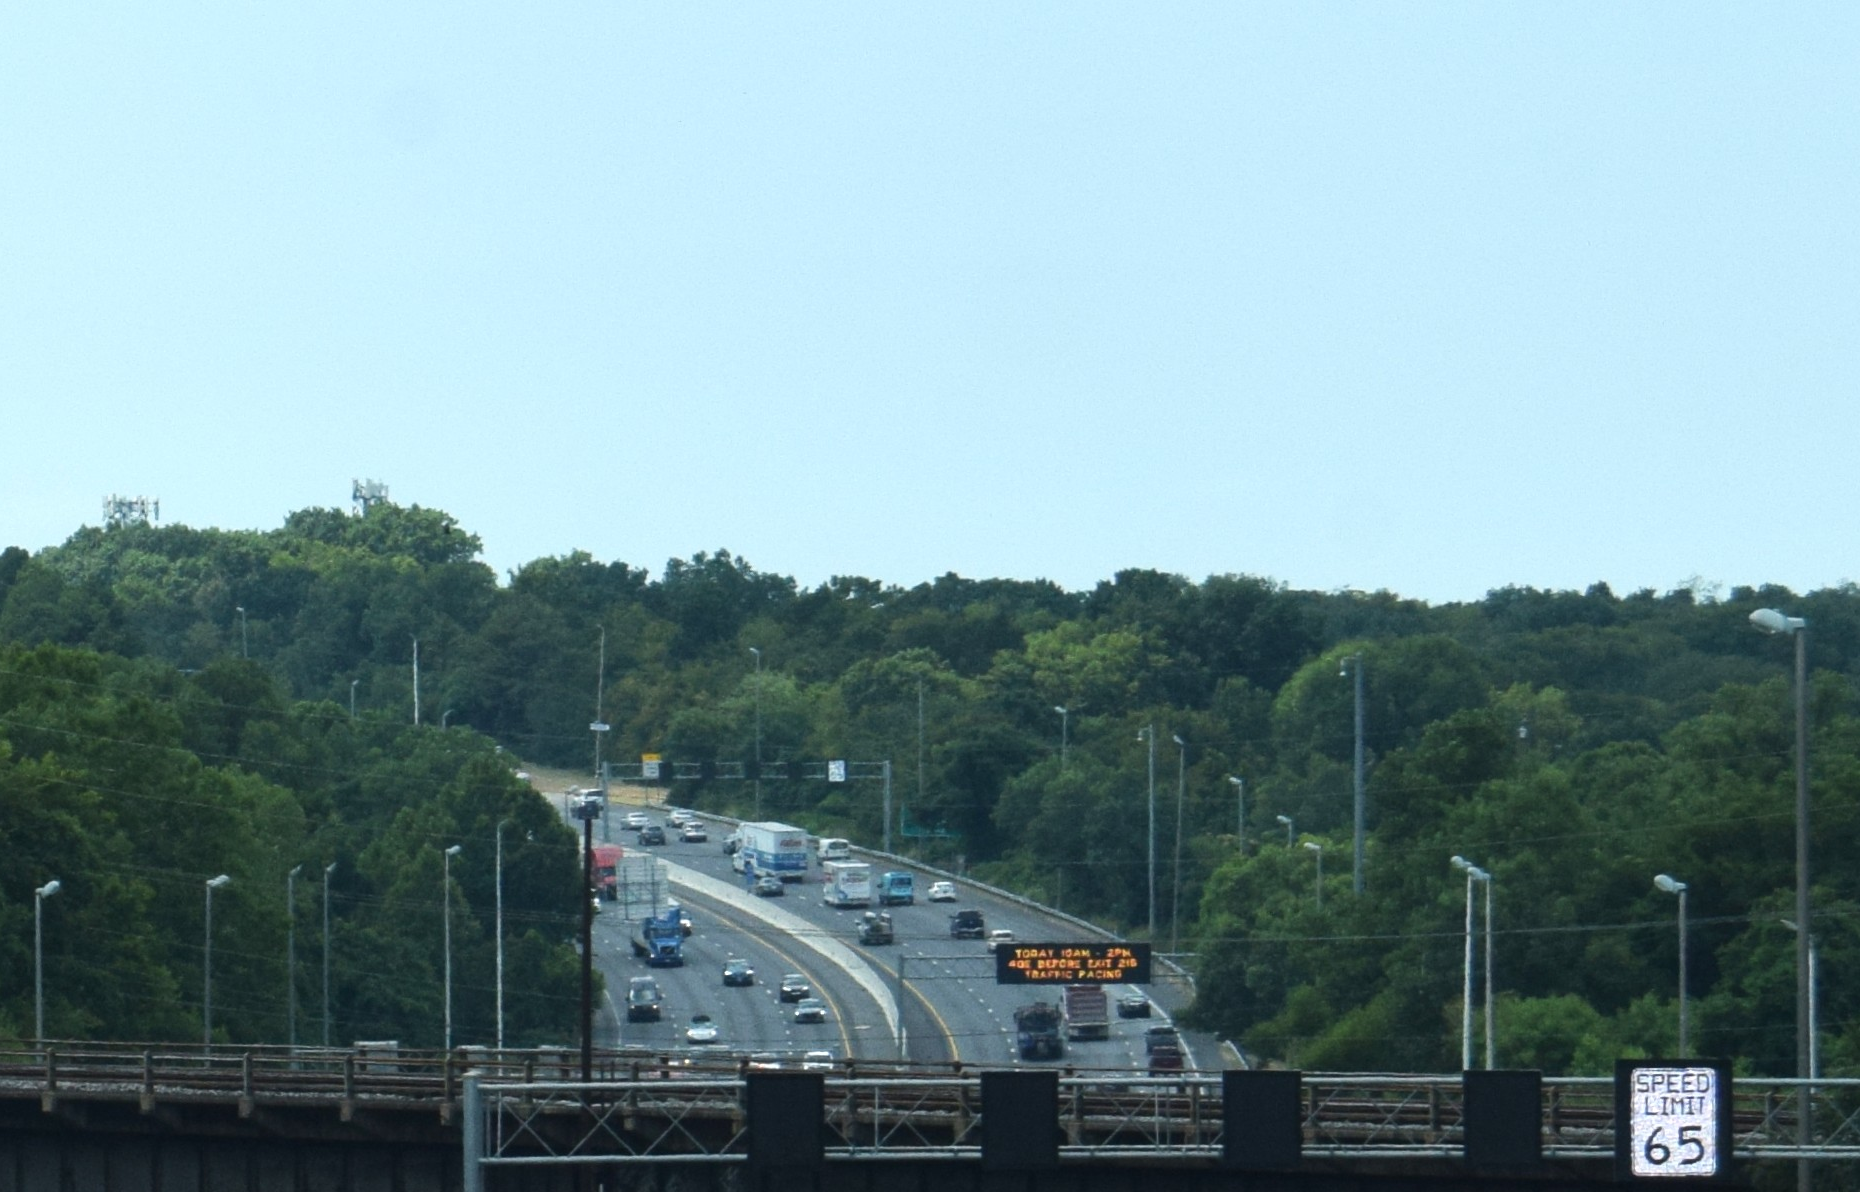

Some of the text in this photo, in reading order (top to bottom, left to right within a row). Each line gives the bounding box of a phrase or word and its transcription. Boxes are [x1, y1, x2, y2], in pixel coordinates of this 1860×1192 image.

[1037, 959, 1081, 968] BEFORE
[1087, 959, 1112, 968] EXIT
[1025, 970, 1122, 979] TRAFFIC PACING
[1637, 1073, 1710, 1093] SPEED
[1645, 1096, 1705, 1115] LIMIT
[1644, 1126, 1705, 1165] 65
